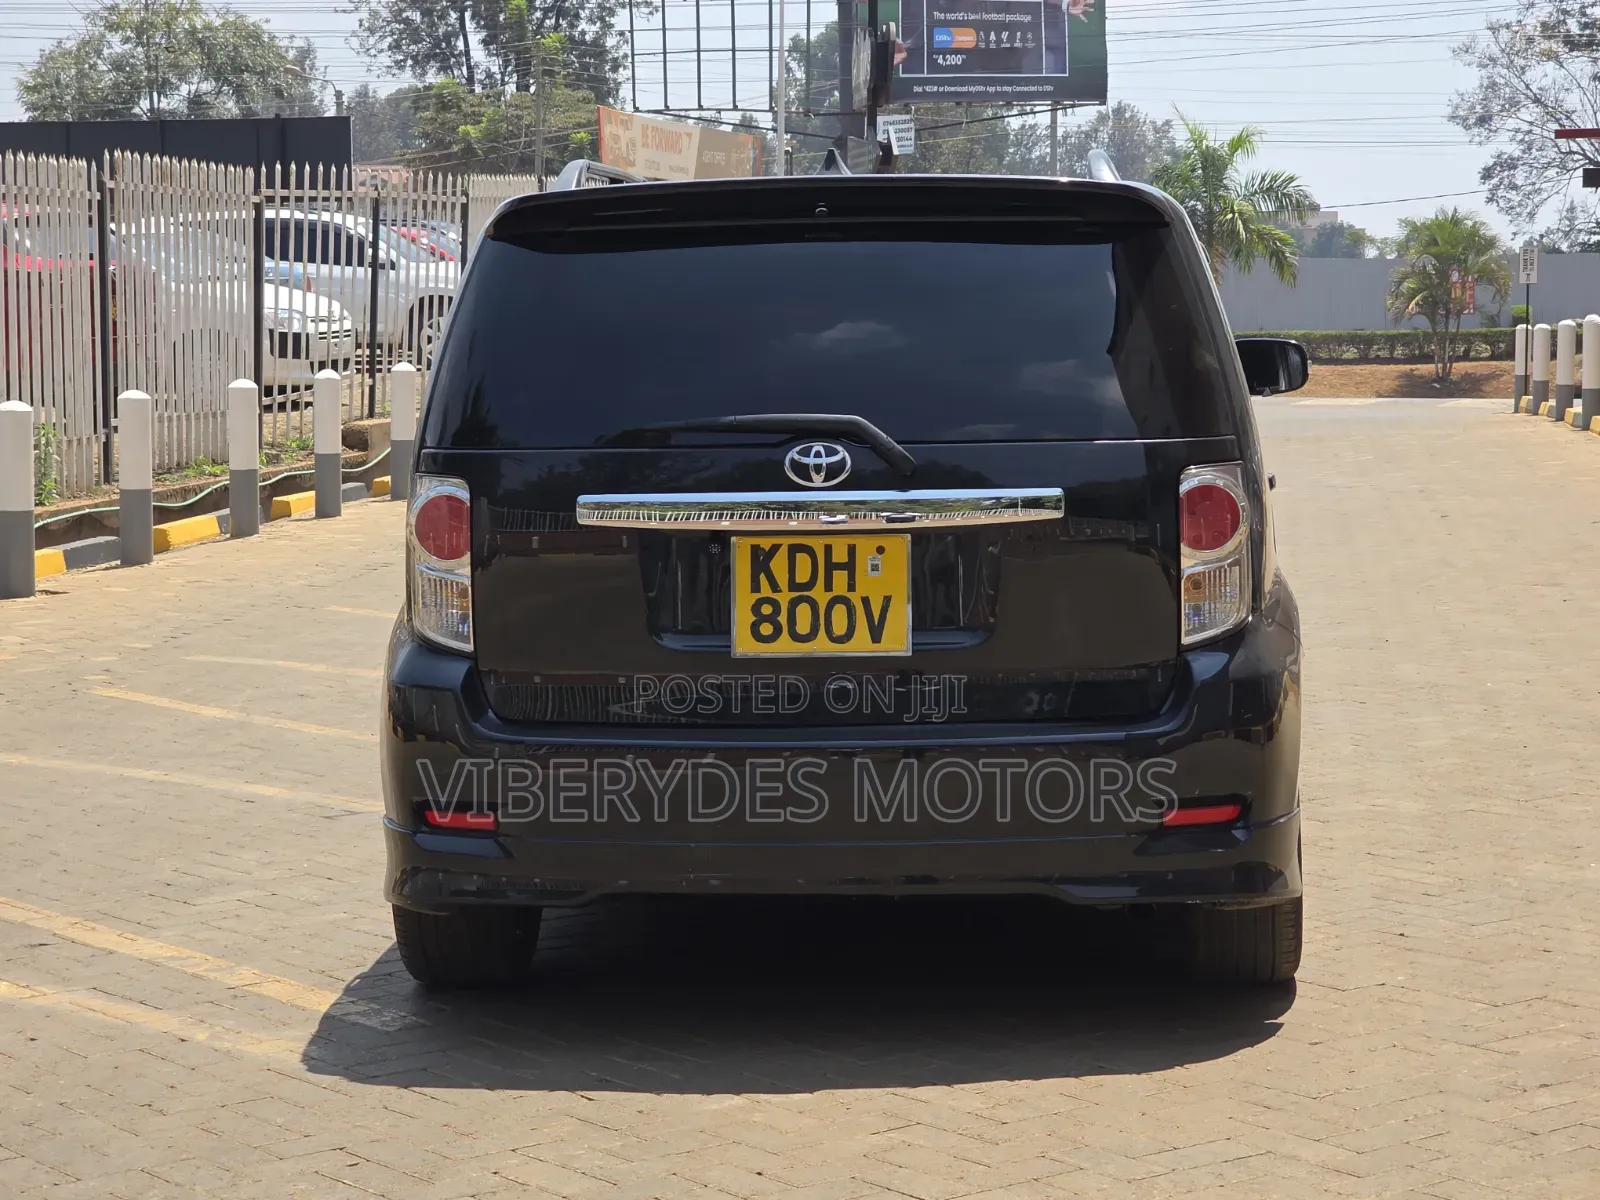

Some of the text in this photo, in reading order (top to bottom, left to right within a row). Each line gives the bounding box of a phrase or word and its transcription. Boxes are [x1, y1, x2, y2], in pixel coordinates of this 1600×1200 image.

[933, 12, 1032, 23] The world's best football package
[986, 85, 996, 93] App
[1002, 85, 1012, 93] stay
[641, 124, 683, 156] BE FORWARD
[750, 543, 857, 594] KDH
[749, 594, 893, 645] 800V
